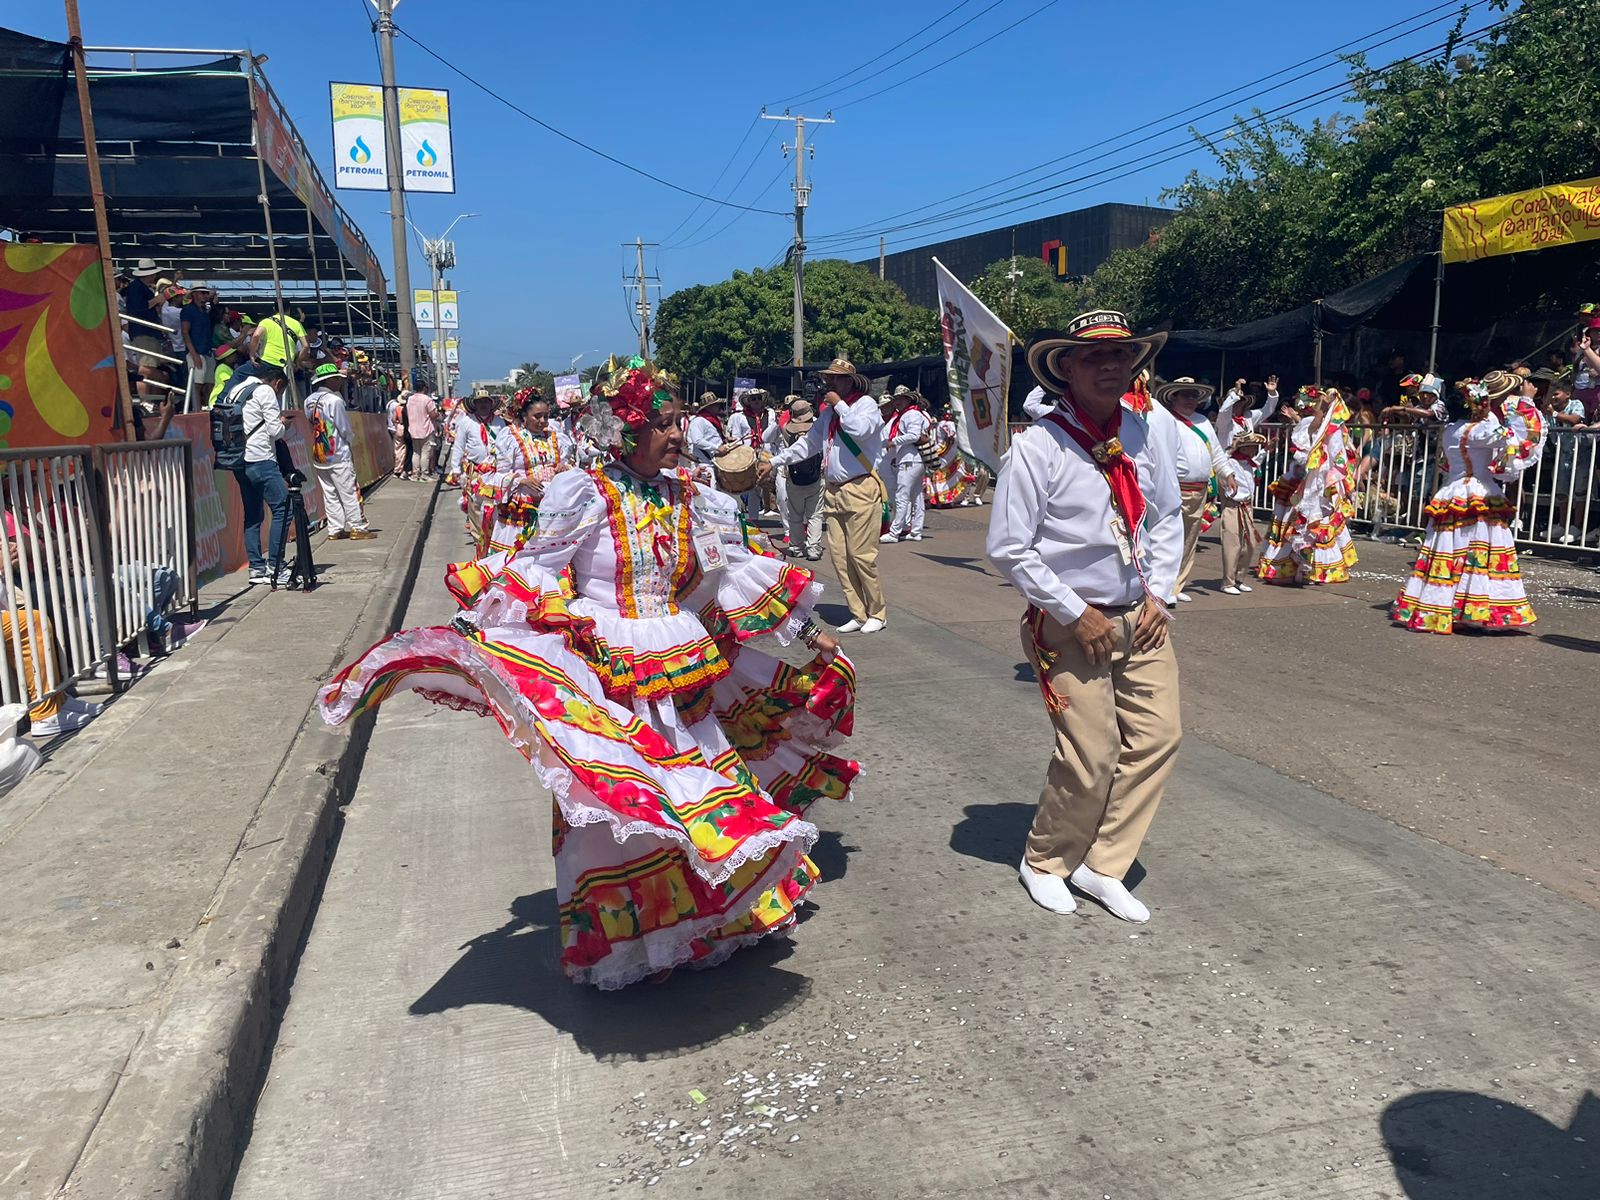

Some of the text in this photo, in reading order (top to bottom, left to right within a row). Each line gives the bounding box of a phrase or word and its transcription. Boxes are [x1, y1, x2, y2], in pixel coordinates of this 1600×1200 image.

[339, 166, 383, 175] PETROMIL
[406, 169, 449, 178] PETROMIL
[1511, 185, 1597, 216] Carnaval
[1531, 226, 1565, 244] 2024
